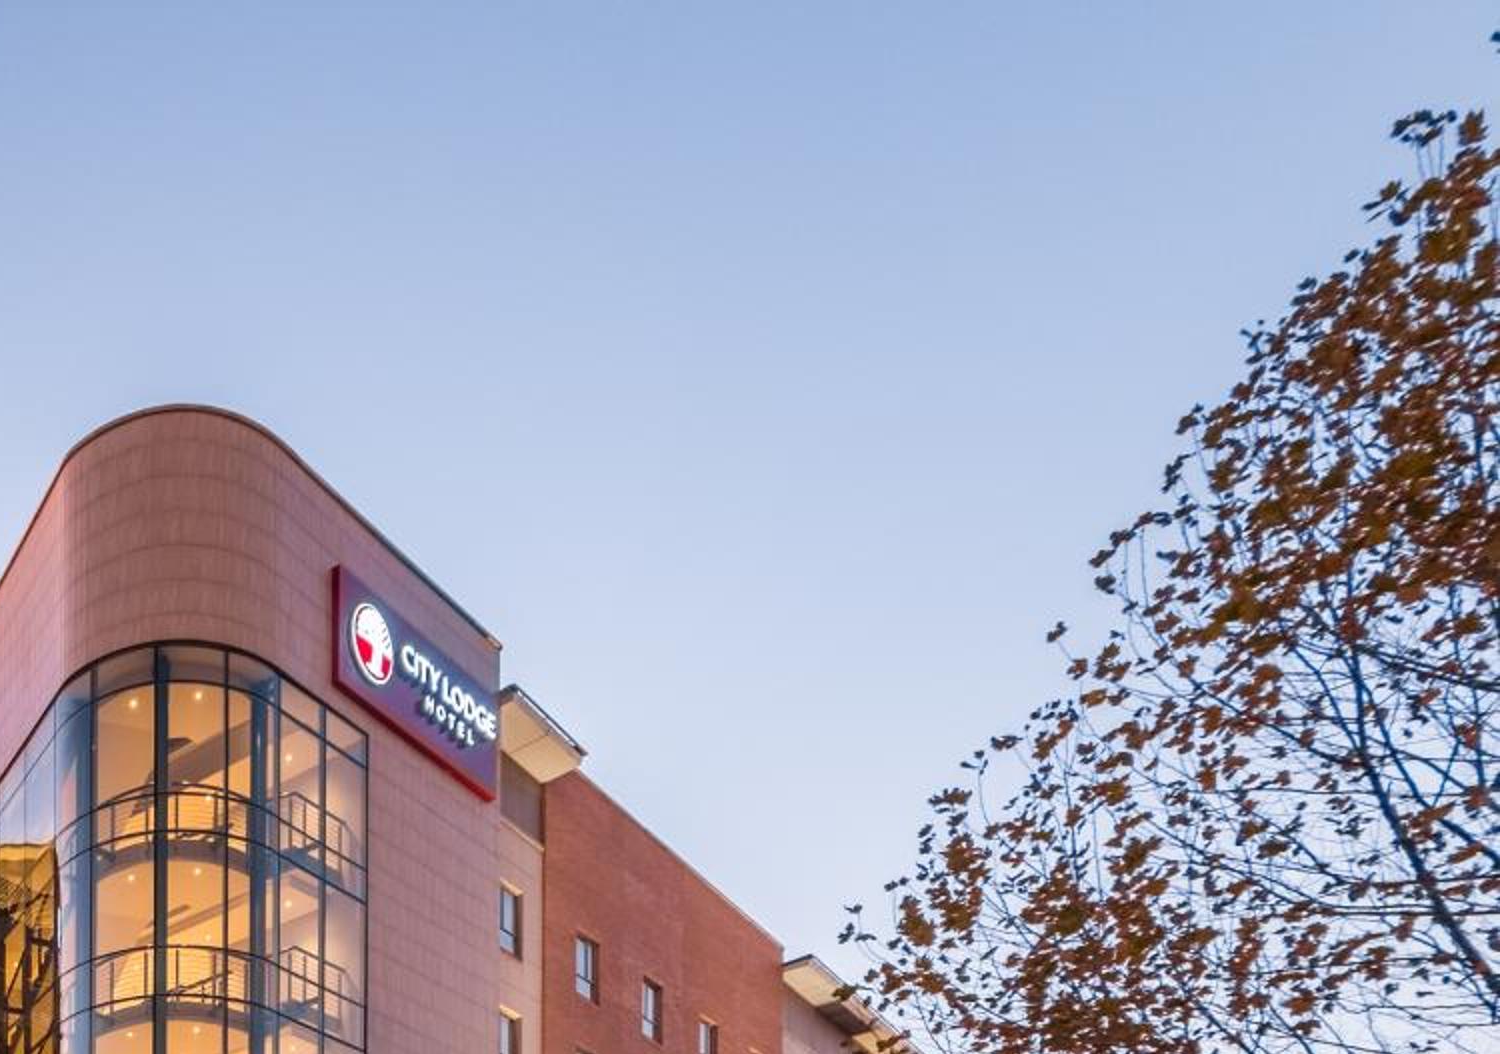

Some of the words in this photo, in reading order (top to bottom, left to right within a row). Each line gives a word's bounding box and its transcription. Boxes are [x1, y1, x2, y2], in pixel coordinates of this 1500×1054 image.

[401, 645, 443, 691] CITY
[441, 676, 496, 740] LODGE
[424, 695, 475, 746] HOTEL
